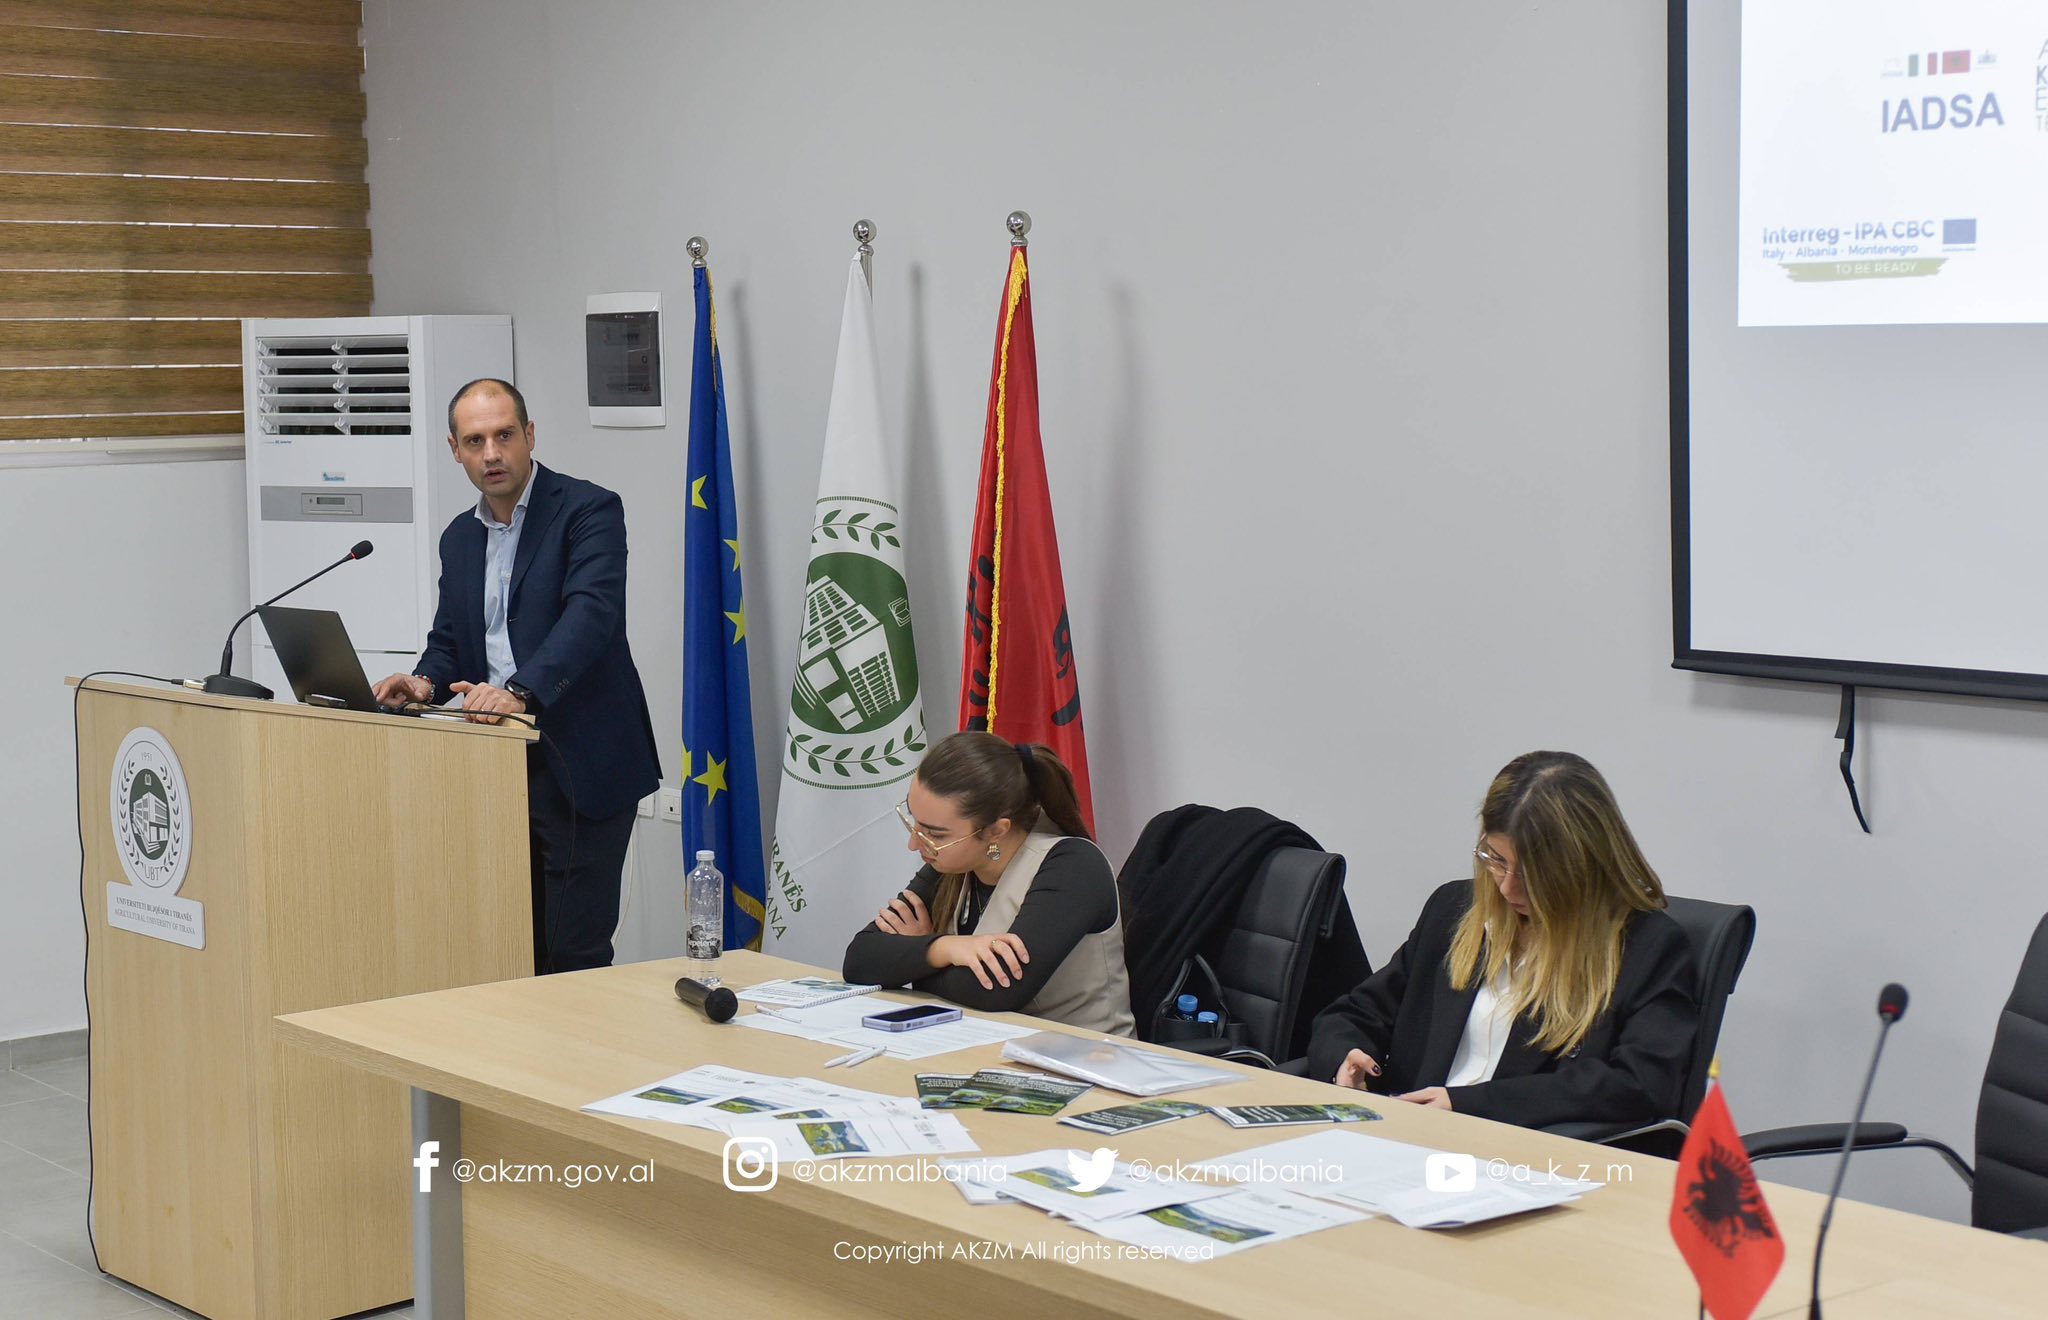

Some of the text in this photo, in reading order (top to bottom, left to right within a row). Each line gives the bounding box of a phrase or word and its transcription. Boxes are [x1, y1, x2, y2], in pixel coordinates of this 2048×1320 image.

[1881, 92, 2005, 133] IADSA
[1763, 226, 1840, 245] Interreg
[1855, 222, 1887, 241] IPA
[1892, 220, 1935, 238] CBC
[1762, 243, 1918, 261] Italy Albania Montenegro
[1836, 262, 1918, 274] TO BE READY
[144, 863, 160, 881] UBT
[772, 834, 807, 913] RANËS
[172, 923, 179, 931] OF
